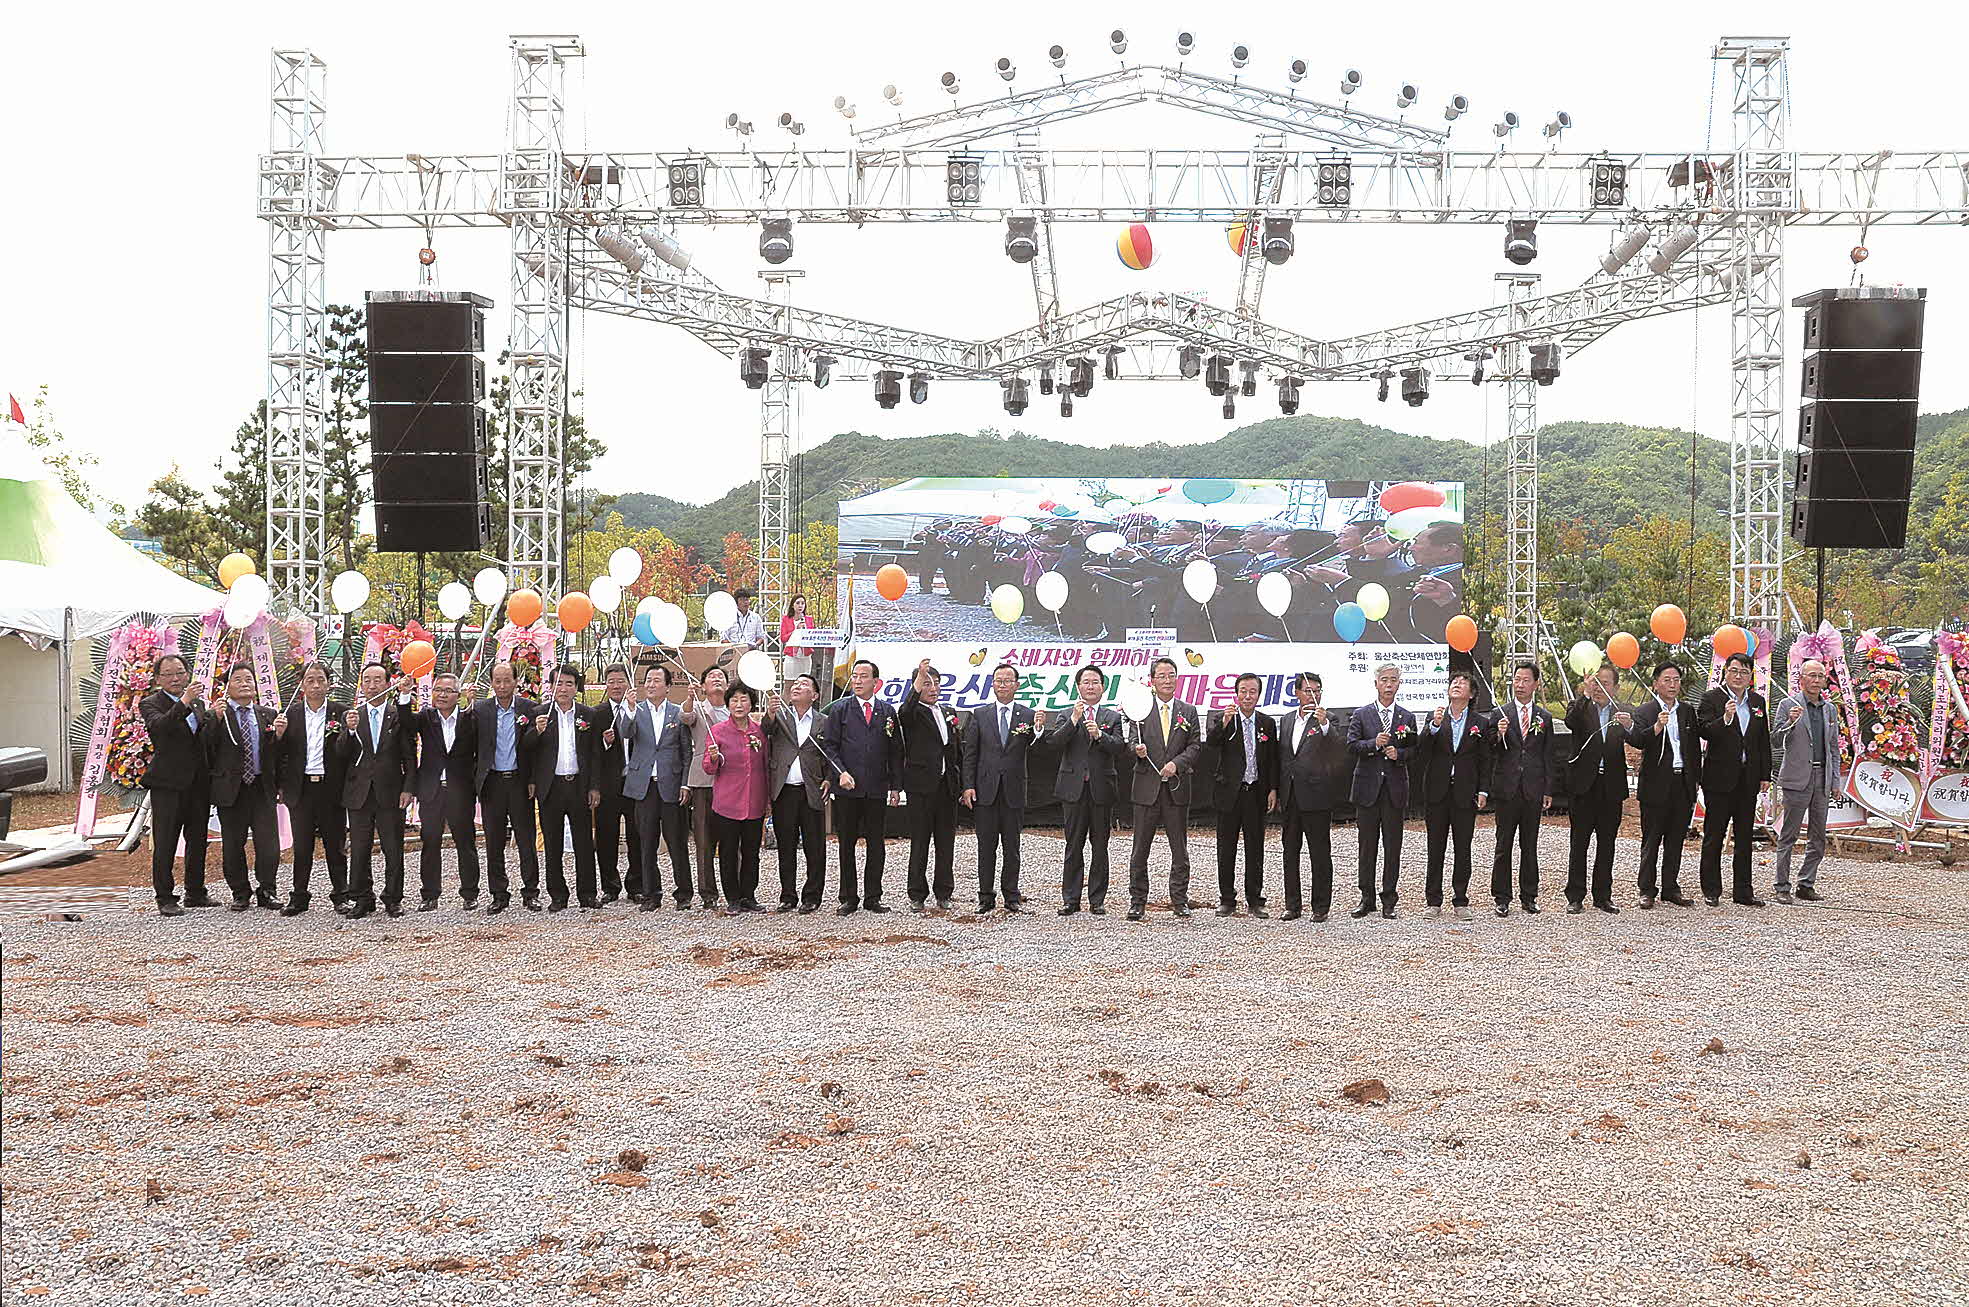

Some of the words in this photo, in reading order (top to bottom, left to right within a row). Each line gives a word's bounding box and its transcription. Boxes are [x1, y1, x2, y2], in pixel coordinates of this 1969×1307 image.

[1000, 648, 1083, 667] 소비자와
[1090, 648, 1170, 668] 함께하는
[1349, 663, 1369, 673] 후원:
[1174, 673, 1301, 710] 마음대
[1880, 768, 1894, 783] 祝
